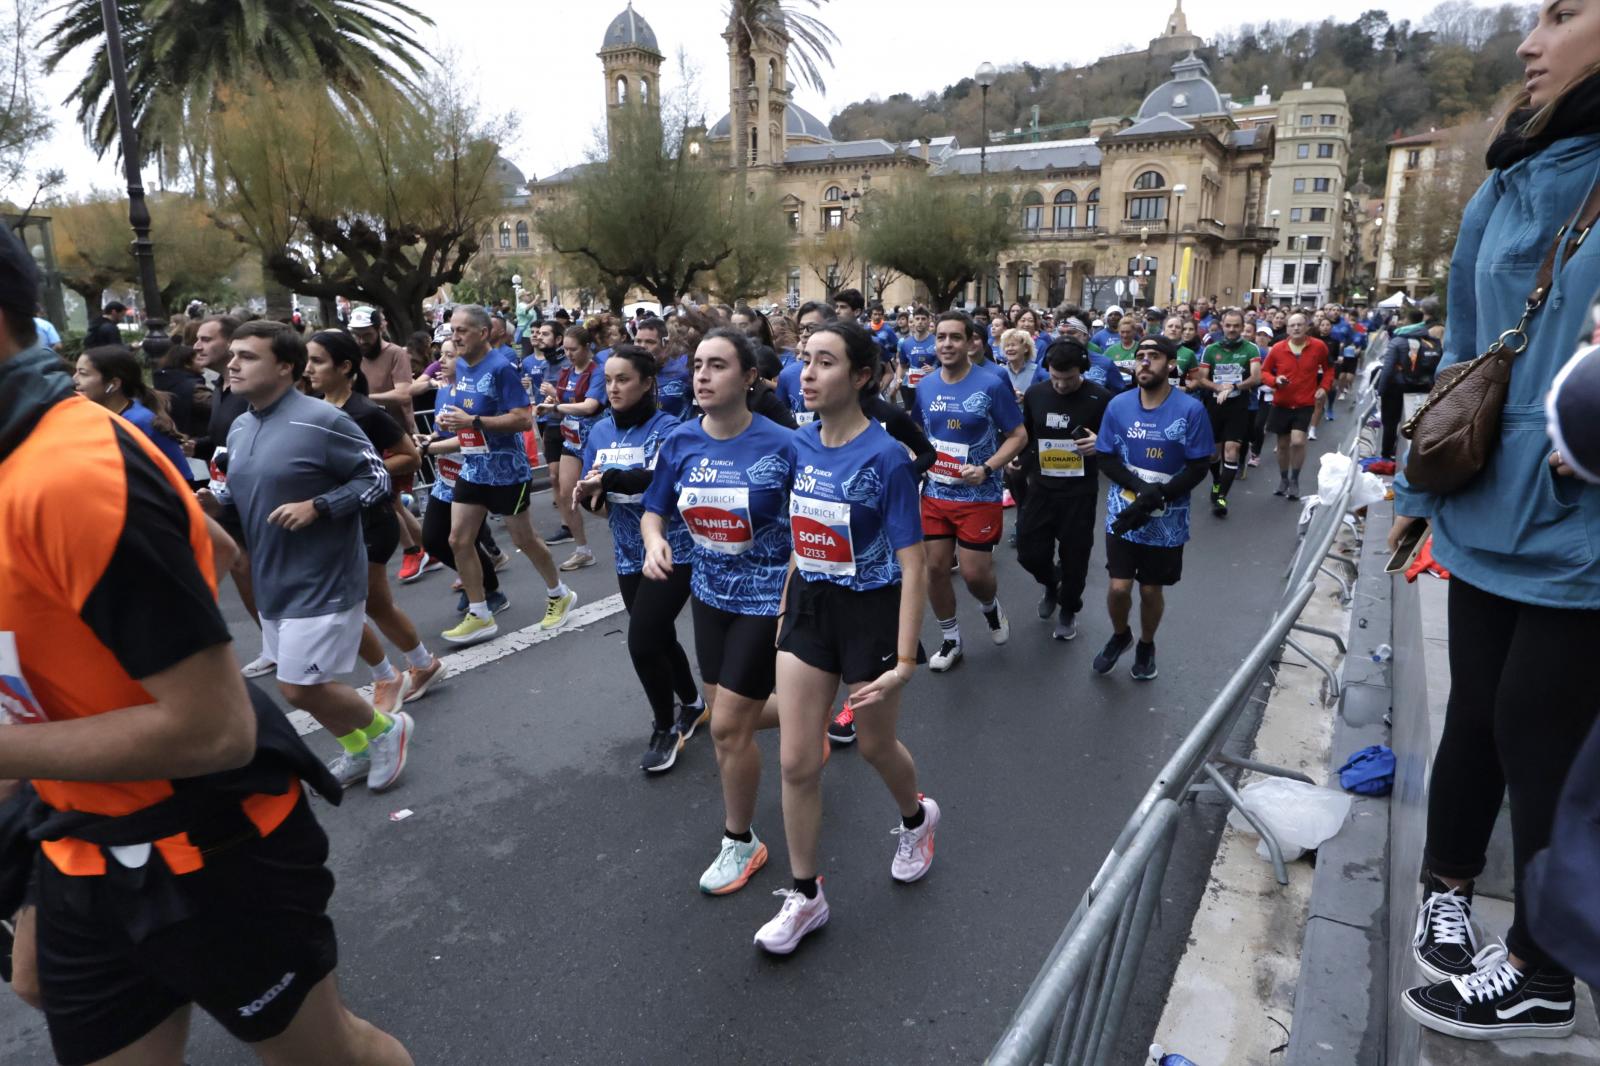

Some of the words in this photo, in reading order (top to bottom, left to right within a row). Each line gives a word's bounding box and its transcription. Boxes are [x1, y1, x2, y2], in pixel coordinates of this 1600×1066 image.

[946, 419, 962, 430] 10k
[1145, 447, 1164, 459] 10k
[711, 459, 734, 467] ZURICH
[813, 468, 833, 478] ZURICH
[701, 495, 735, 504] ZURICH
[802, 505, 836, 519] ZURICH
[694, 517, 745, 529] DANIELA
[799, 531, 837, 547] SOFÍA
[803, 547, 827, 559] 12133
